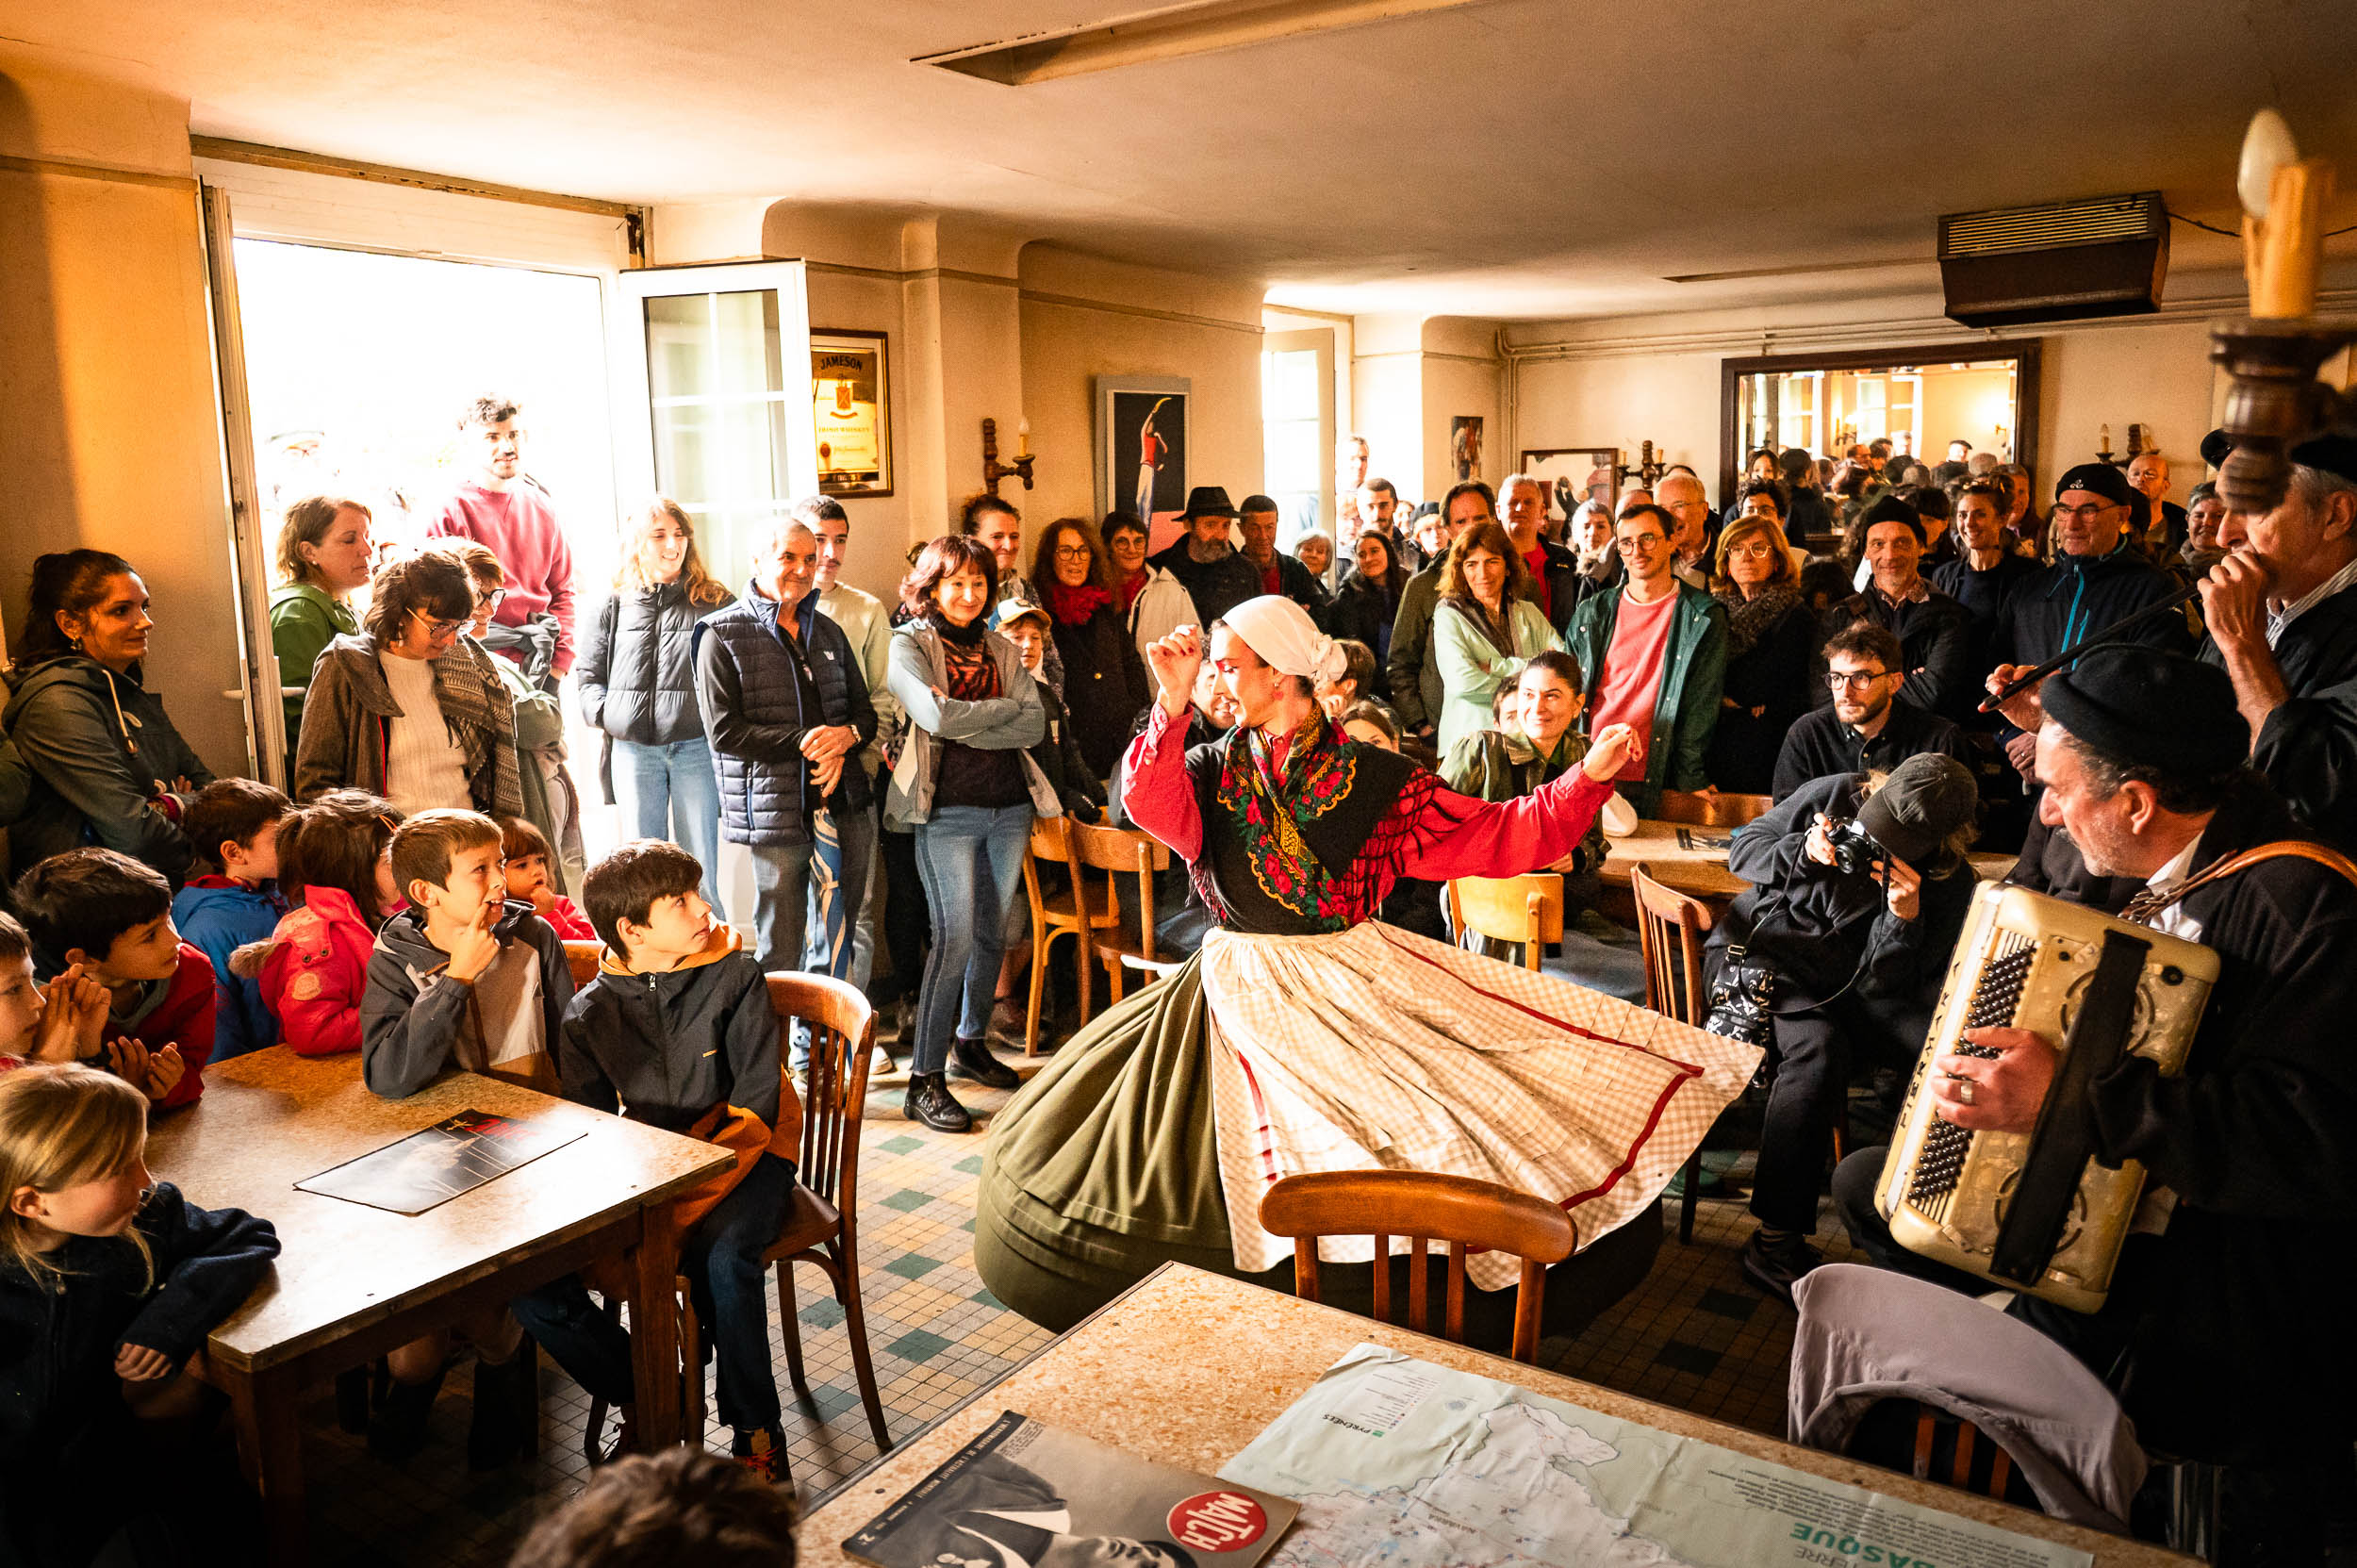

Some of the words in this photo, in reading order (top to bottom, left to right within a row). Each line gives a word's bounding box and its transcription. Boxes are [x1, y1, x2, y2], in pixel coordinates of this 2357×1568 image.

[820, 354, 863, 371] JAMESON
[1179, 1493, 1256, 1552] MATCH
[1793, 1545, 1857, 1568] ERRE
